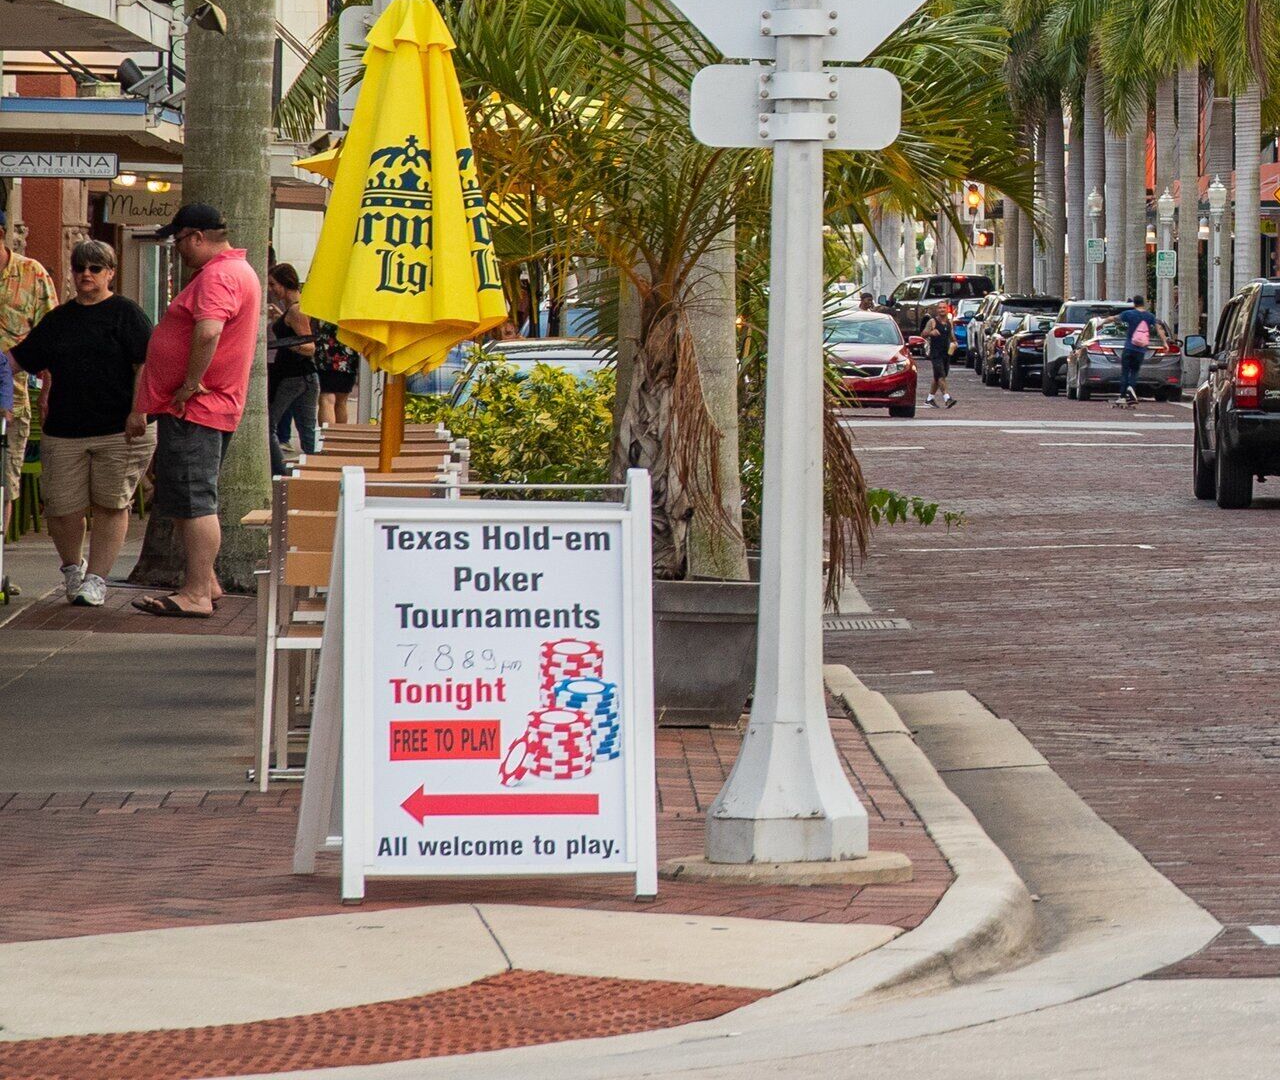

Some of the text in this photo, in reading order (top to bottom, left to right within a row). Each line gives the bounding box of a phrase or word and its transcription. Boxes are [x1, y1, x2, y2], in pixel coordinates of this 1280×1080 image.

[0, 155, 110, 168] CANTINA
[108, 194, 174, 218] Market
[382, 525, 611, 551] Texas Hold-em
[453, 566, 543, 591] Poker
[395, 603, 600, 629] Tournaments
[434, 644, 454, 671] 8
[389, 677, 506, 710] Tonight
[393, 727, 497, 752] FREE TO PLAY
[377, 835, 620, 859] All welcome to play.
